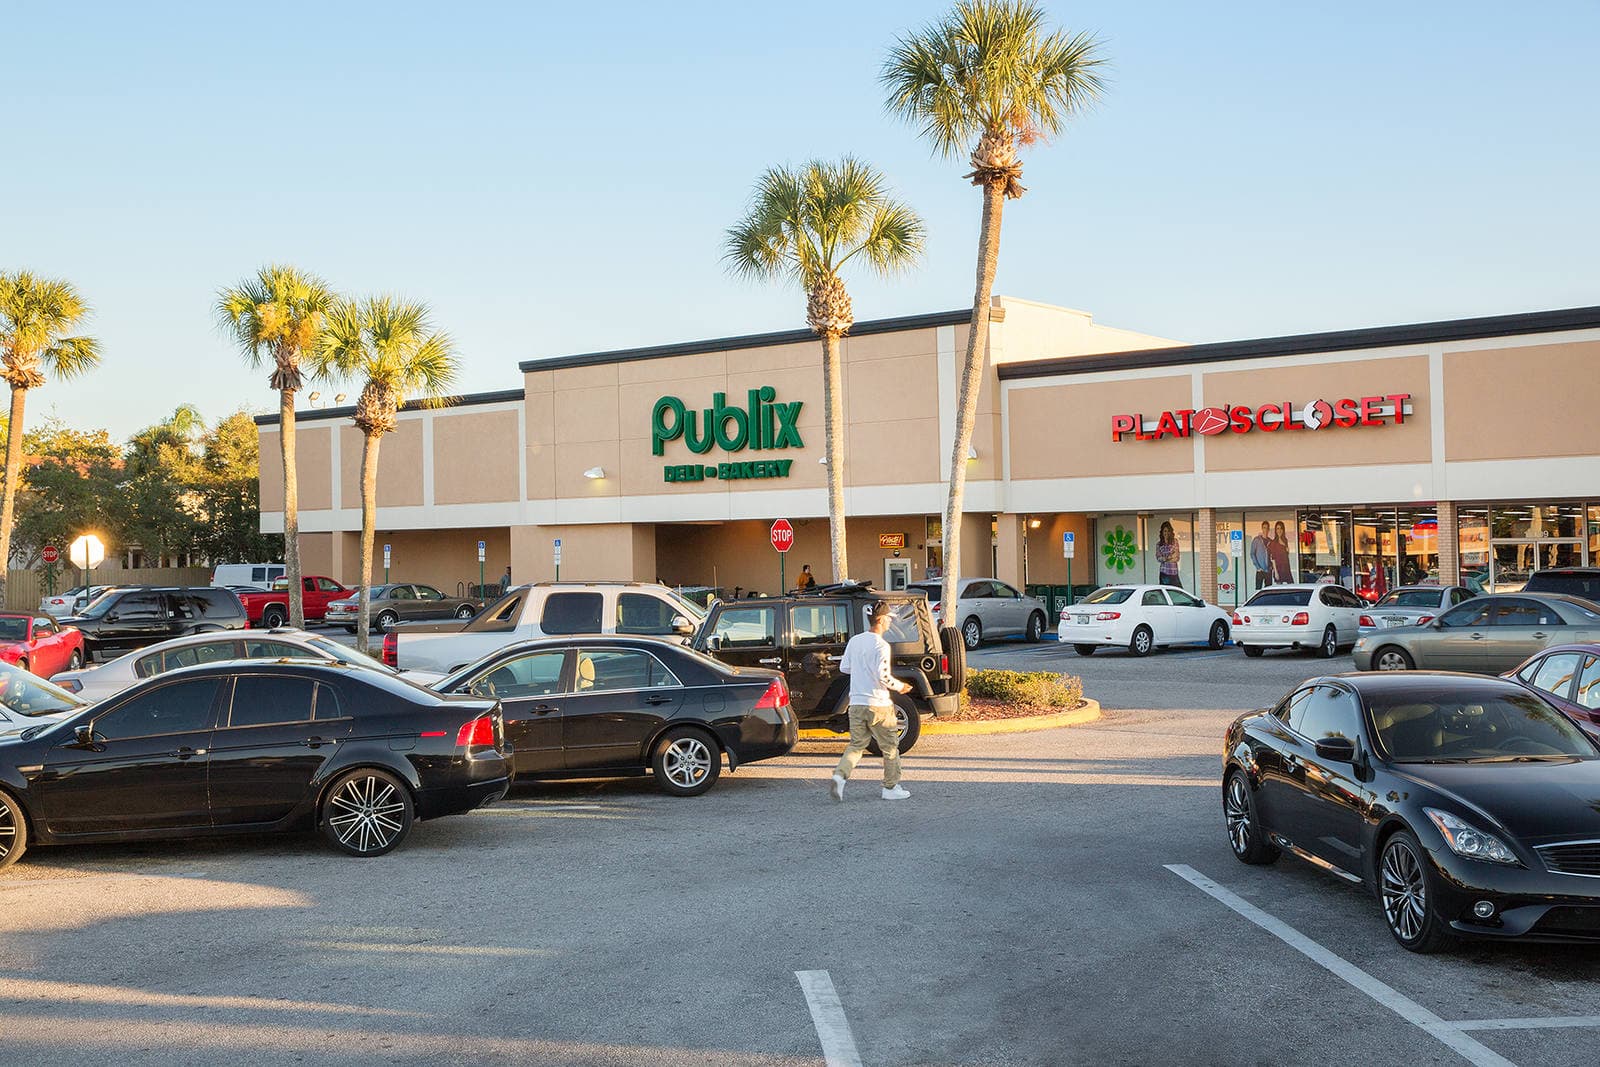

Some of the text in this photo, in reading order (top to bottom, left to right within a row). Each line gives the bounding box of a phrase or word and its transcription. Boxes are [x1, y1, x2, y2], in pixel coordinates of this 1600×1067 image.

[652, 386, 804, 456] Publix
[1111, 394, 1411, 442] PLATO'S CLOSET
[664, 459, 793, 482] DELI BAKERY
[772, 529, 792, 542] STOP
[43, 550, 58, 558] STOP
